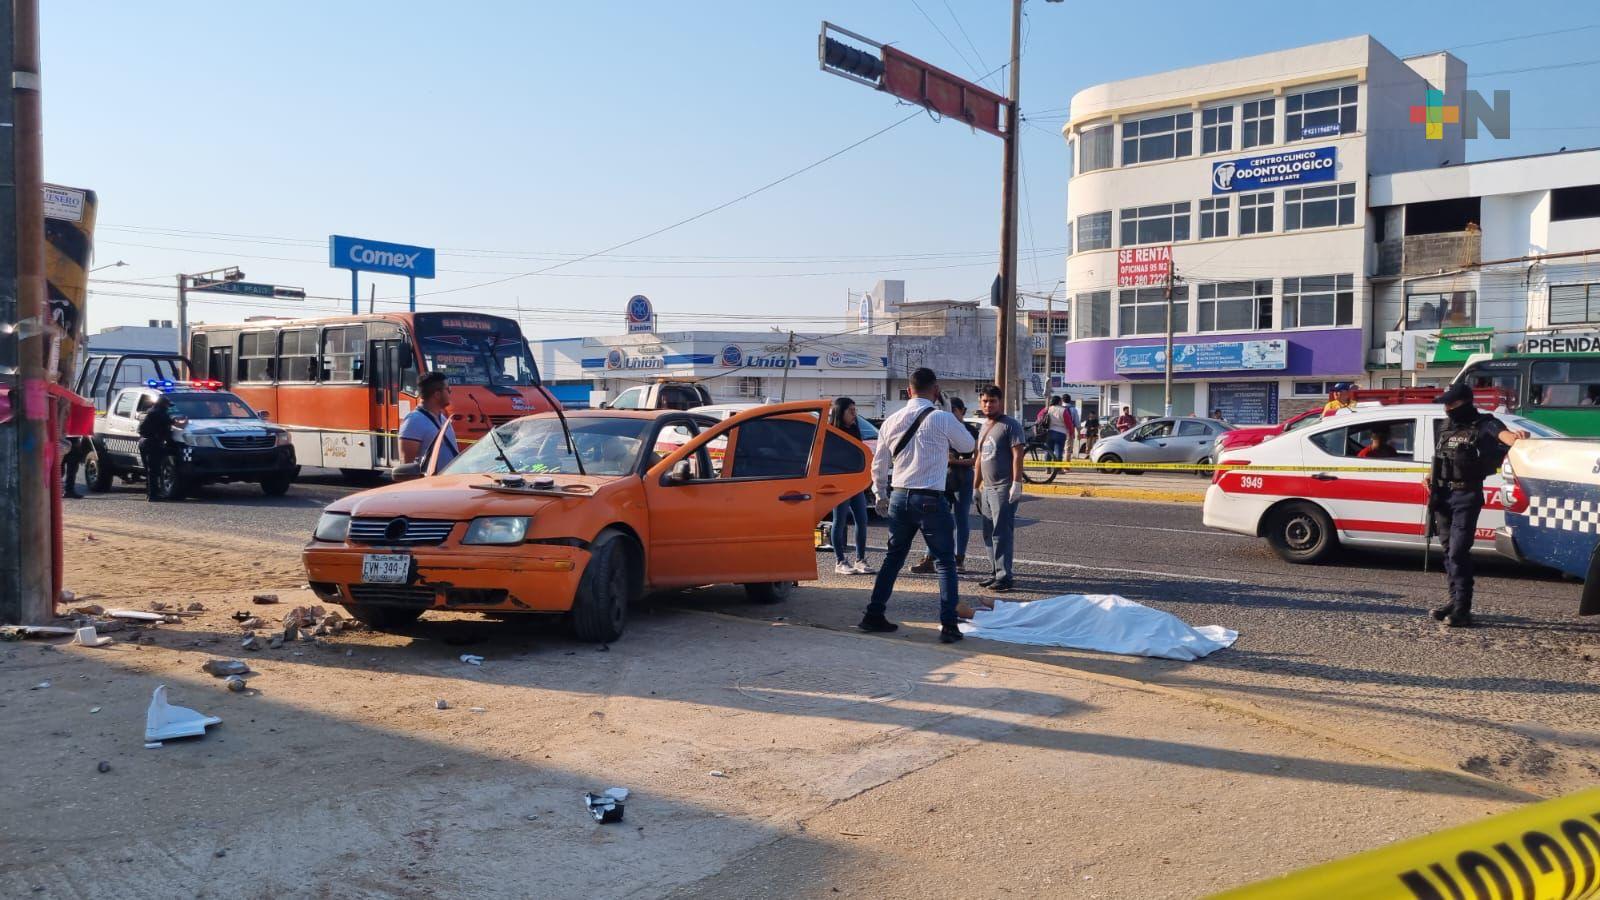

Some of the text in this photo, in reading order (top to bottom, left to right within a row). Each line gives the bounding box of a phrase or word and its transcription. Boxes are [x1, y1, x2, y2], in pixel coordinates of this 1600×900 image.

[1250, 151, 1316, 166] CENTRO CLINICO
[1236, 158, 1333, 179] ODONTOLOGICO
[349, 244, 421, 269] Comex
[1120, 246, 1170, 263] SE RENTA
[1120, 264, 1149, 274] OFICINAS
[746, 355, 798, 368] Unión
[1240, 476, 1263, 488] 3949
